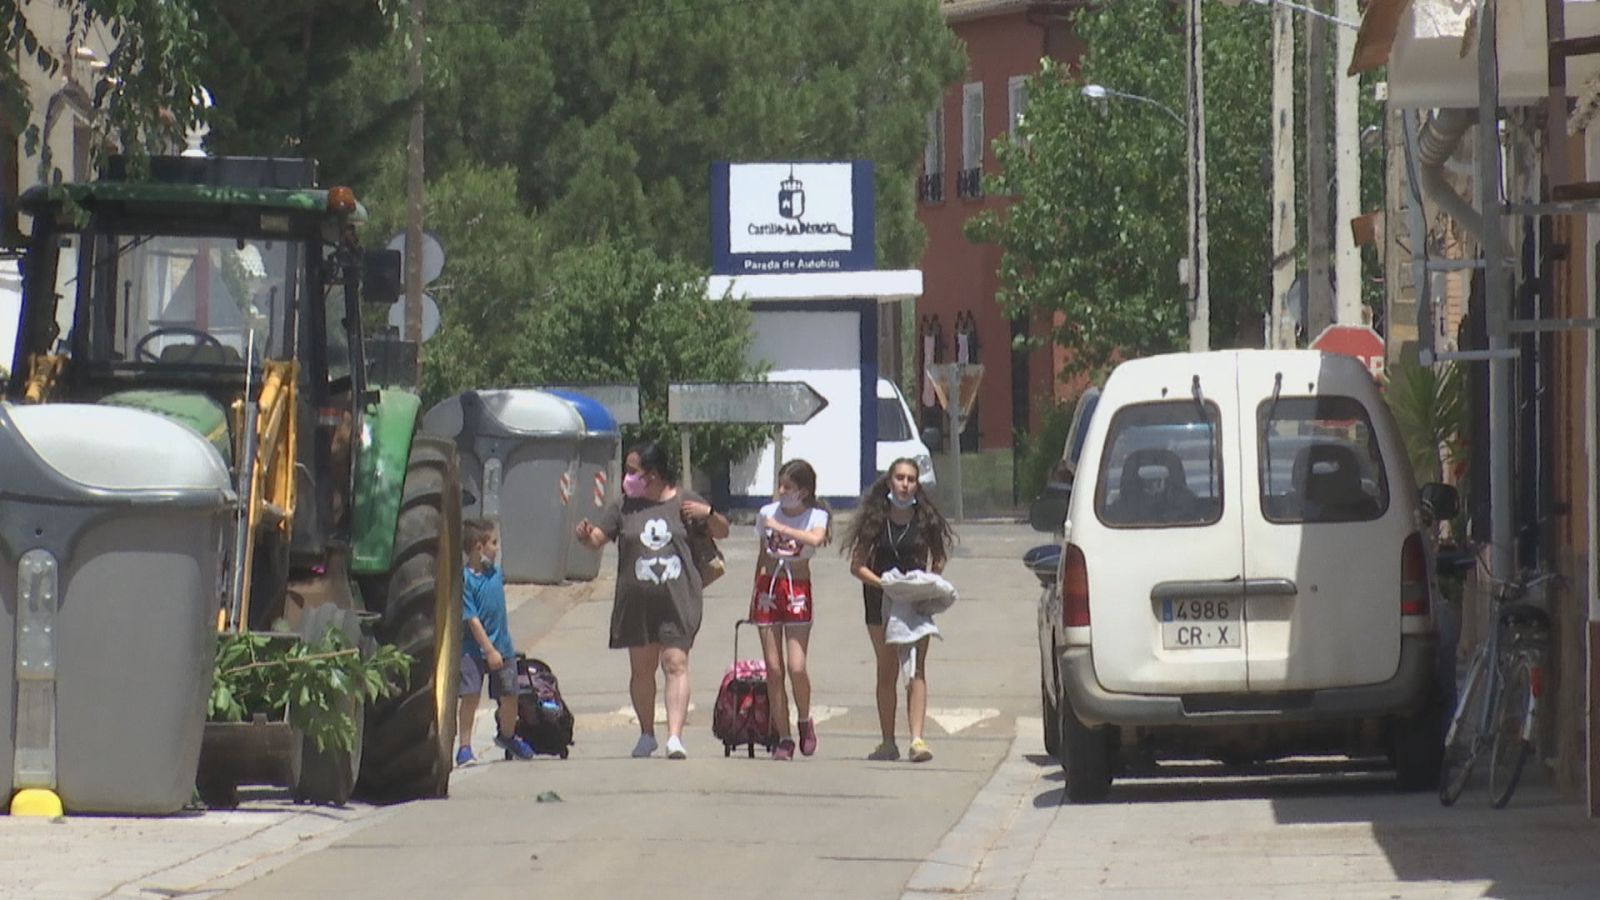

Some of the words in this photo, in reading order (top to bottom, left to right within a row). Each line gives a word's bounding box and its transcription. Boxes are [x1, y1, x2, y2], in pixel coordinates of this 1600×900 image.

[745, 259, 780, 270] Parada
[782, 259, 796, 269] de
[797, 257, 840, 269] Autobús
[1177, 600, 1228, 620] 4986
